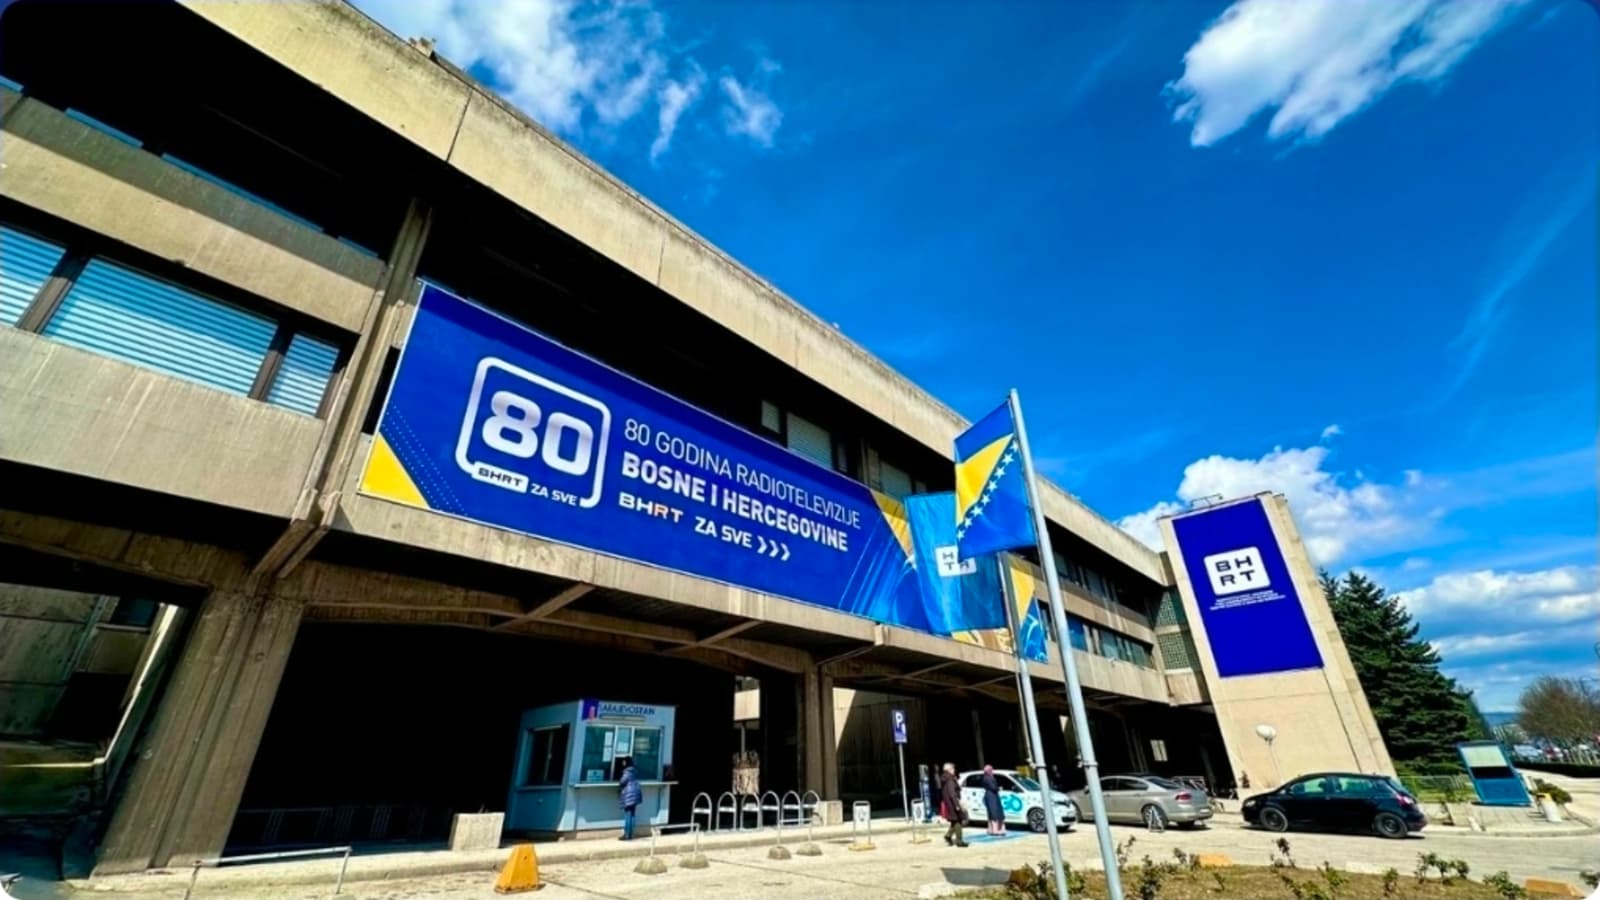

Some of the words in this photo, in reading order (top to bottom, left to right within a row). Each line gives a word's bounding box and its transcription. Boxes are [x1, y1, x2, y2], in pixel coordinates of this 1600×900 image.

[482, 390, 594, 476] 80
[478, 466, 523, 487] BHRT
[530, 482, 549, 498] ZA
[551, 489, 577, 506] SVE
[624, 418, 650, 446] 80
[655, 431, 732, 480] GODINA
[736, 463, 861, 530] RADIOTELEVIZIJE
[618, 491, 684, 524] BHRT
[694, 516, 718, 538] ZA
[721, 527, 752, 549] SVE
[621, 450, 706, 503] BOSNE
[711, 484, 718, 507] I
[722, 488, 849, 552] HERCEGOVINE
[1215, 556, 1252, 572] BH
[1219, 570, 1254, 586] RT
[895, 711, 904, 729] P
